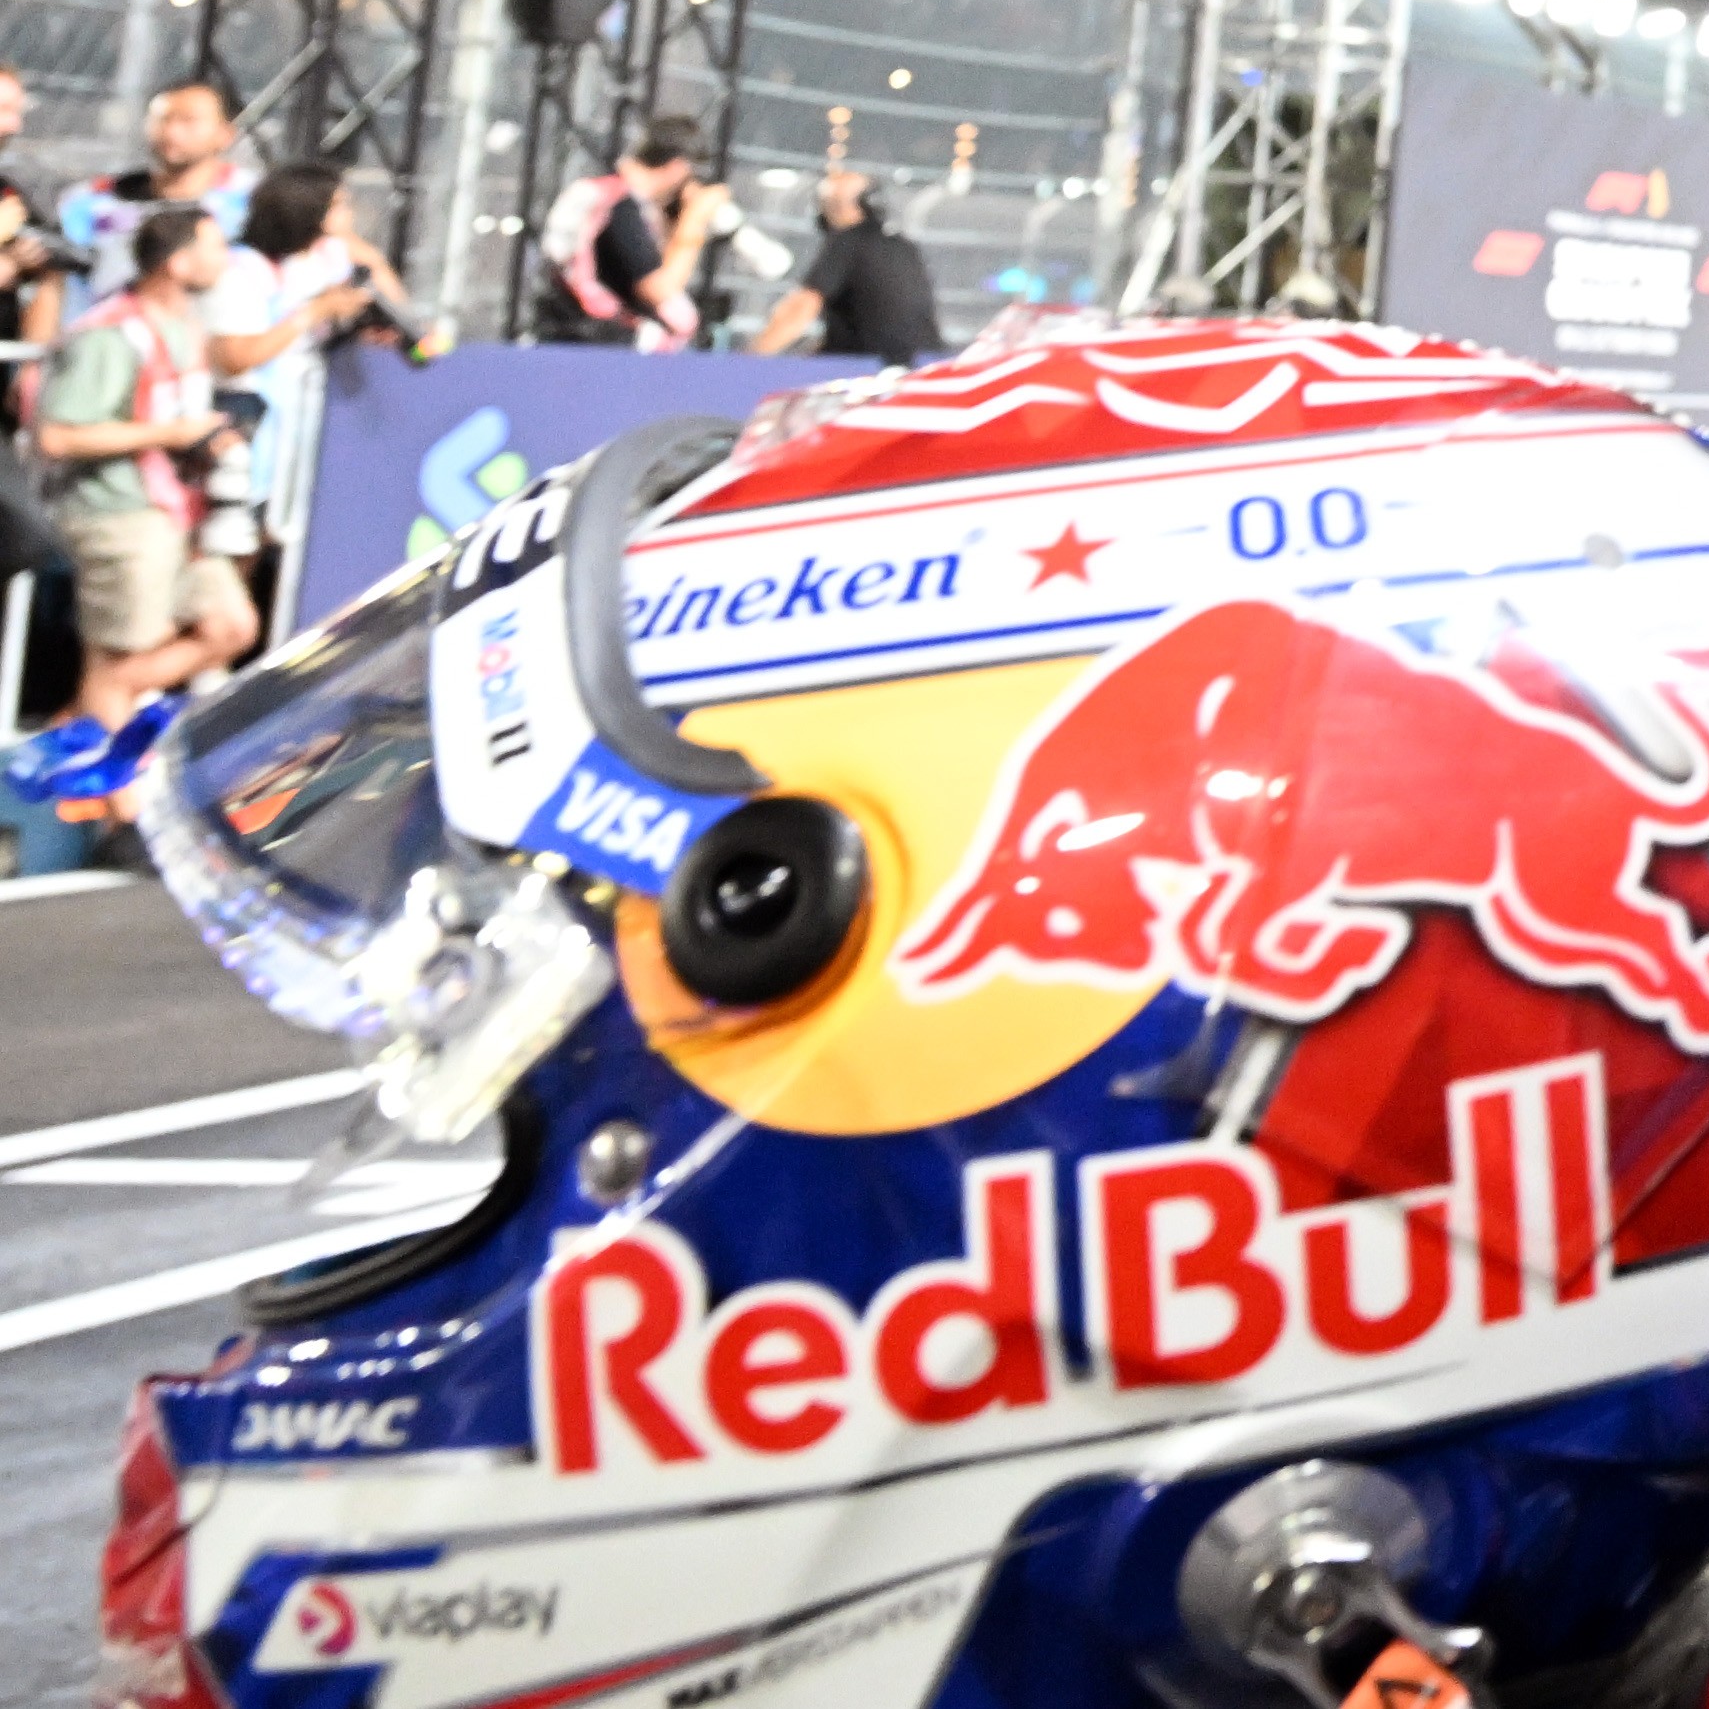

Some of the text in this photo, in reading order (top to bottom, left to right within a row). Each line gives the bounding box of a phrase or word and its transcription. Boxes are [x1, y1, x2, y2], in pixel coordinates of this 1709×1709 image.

[624, 552, 962, 642] eineken
[555, 769, 692, 873] VISA
[540, 1064, 1604, 1480] Red Bull
